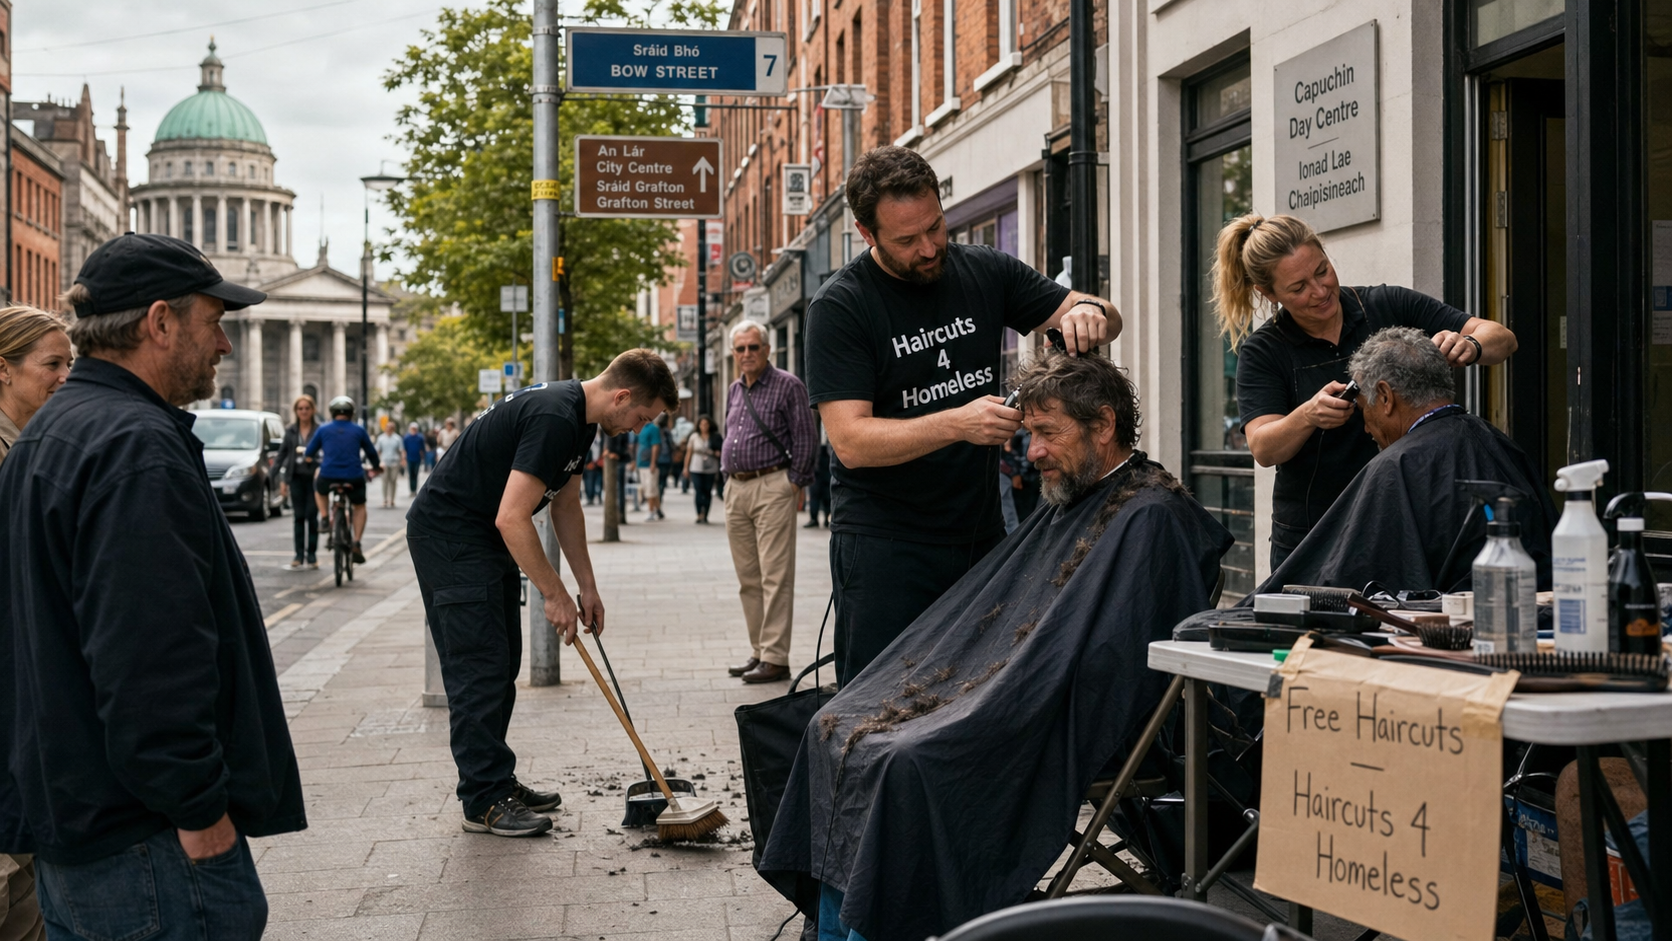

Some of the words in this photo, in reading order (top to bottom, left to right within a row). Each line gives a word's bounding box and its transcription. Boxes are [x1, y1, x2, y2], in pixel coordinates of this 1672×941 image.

[633, 43, 670, 58] Sráid
[674, 44, 700, 57] Bhó
[763, 54, 778, 77] 7
[611, 64, 648, 78] BOW
[656, 65, 718, 79] STREET
[1294, 63, 1355, 104] Capuchin
[1289, 116, 1312, 140] Day
[1316, 100, 1359, 129] Centre
[598, 145, 617, 157] An
[623, 144, 645, 157] Lár
[1298, 152, 1328, 181] Ionad
[1331, 150, 1352, 171] Lae
[596, 161, 623, 175] City
[628, 161, 673, 174] Centre
[596, 179, 630, 193] Sráid
[635, 180, 685, 193] Grafton
[1288, 171, 1365, 210] Chaipisineach
[596, 196, 648, 209] Grafton
[654, 197, 695, 209] Street
[891, 316, 977, 358] Haircuts
[936, 348, 951, 370] 4
[902, 366, 994, 409] Homeless
[1285, 686, 1342, 734] Free
[1356, 691, 1464, 756] Haircuts
[1293, 769, 1395, 838] Haircuts
[1410, 801, 1431, 858] 4
[1316, 831, 1441, 911] Homeless
